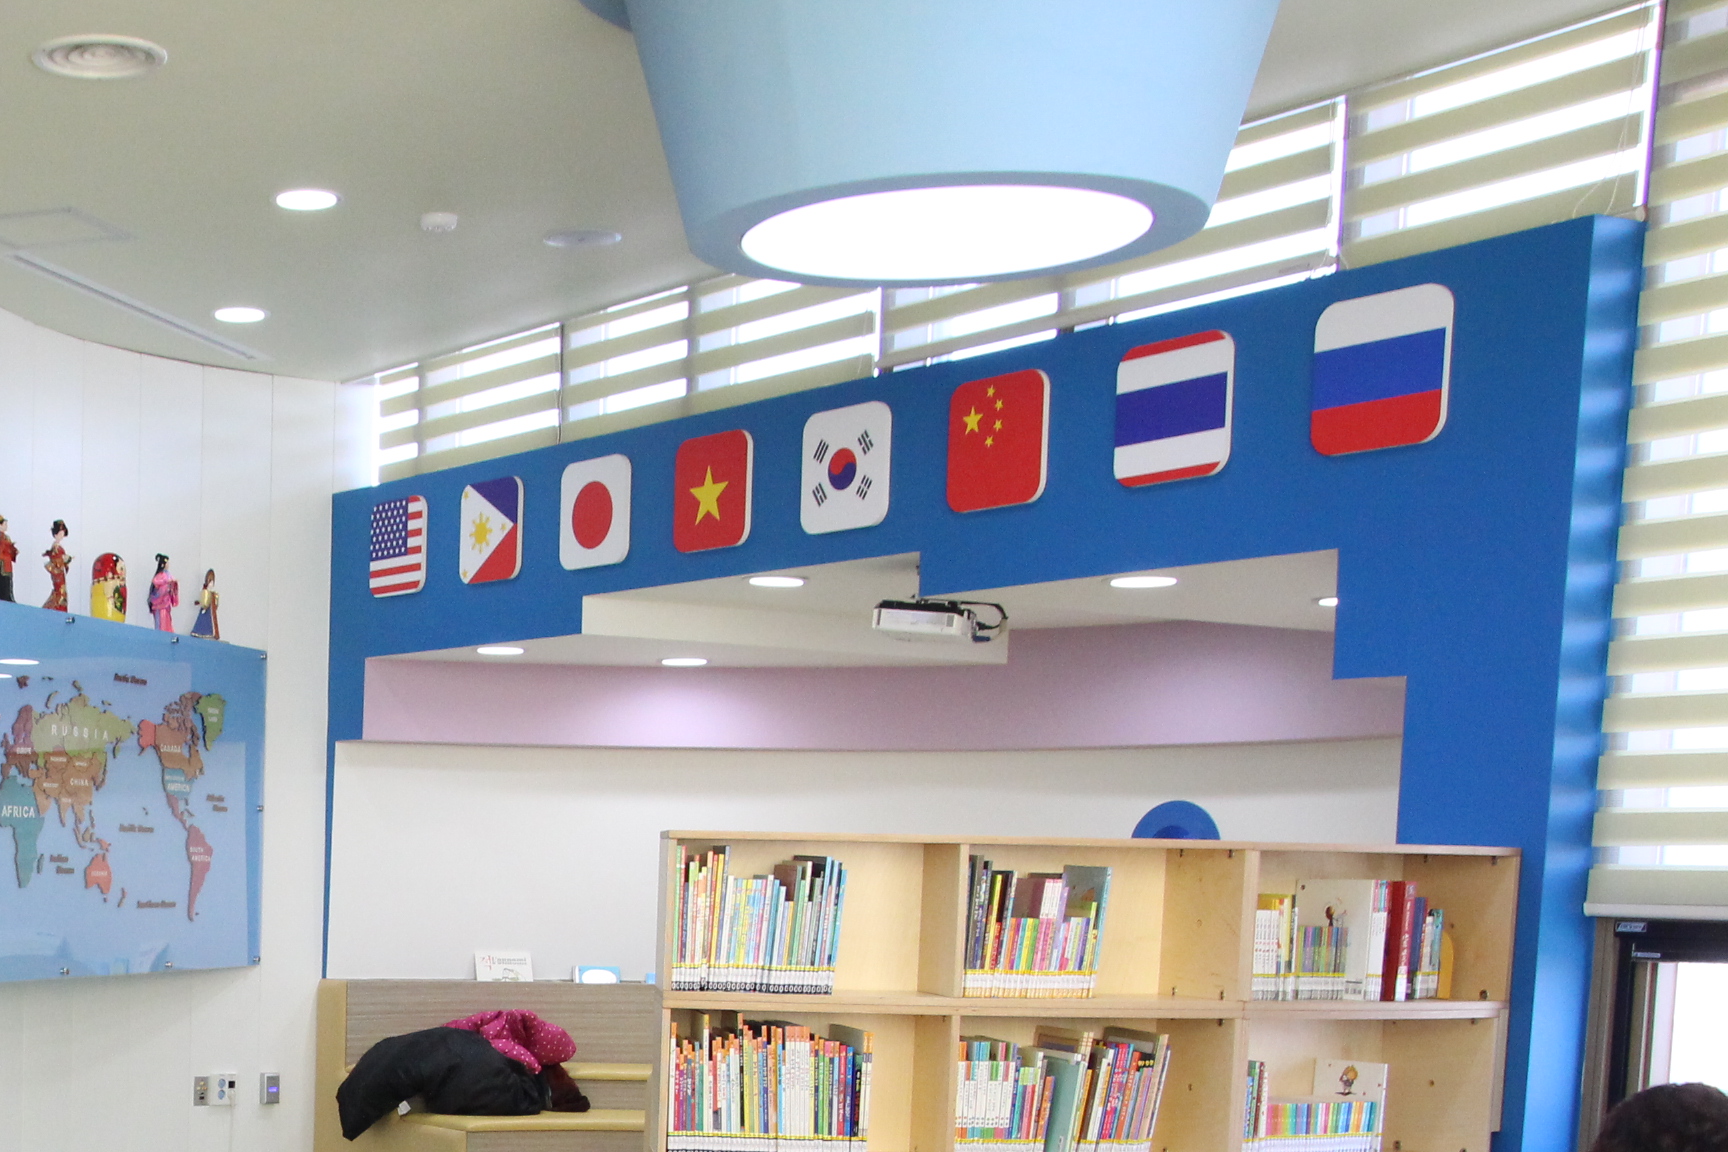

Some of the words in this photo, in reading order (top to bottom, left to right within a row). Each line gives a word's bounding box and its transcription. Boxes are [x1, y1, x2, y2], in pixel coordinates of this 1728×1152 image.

[51, 724, 109, 741] RUSSIA
[69, 777, 89, 787] CHINA
[1, 805, 36, 818] AFRICA
